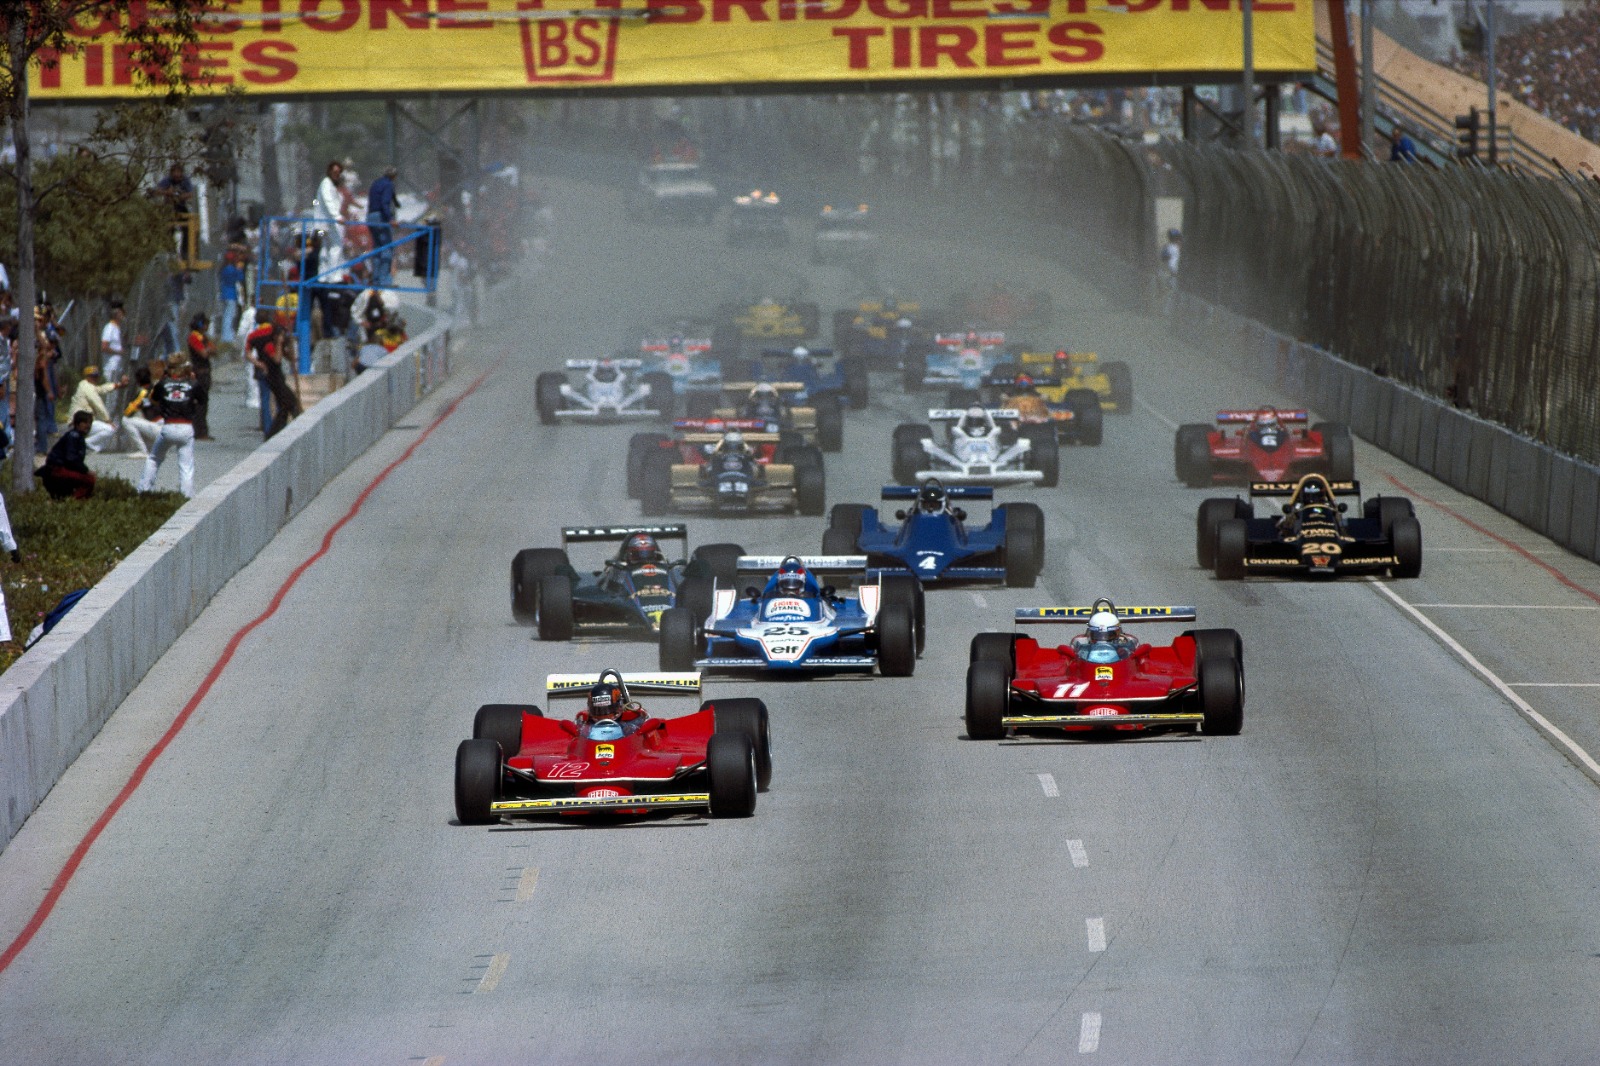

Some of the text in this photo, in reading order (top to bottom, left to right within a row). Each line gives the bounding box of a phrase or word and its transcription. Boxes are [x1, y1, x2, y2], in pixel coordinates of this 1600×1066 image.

[645, 0, 1296, 24] BRIDGE
[538, 18, 602, 69] BS
[832, 21, 1105, 70] TIRES
[37, 40, 299, 88] TIRES
[1253, 482, 1354, 490] OLYUS
[1301, 542, 1342, 555] 20
[918, 556, 937, 570] 4
[1342, 556, 1392, 564] OLYMPUS
[770, 605, 804, 613] GITANES
[763, 626, 810, 637] 25
[770, 645, 799, 654] elf
[1053, 681, 1091, 698] 11
[546, 762, 591, 778] 12
